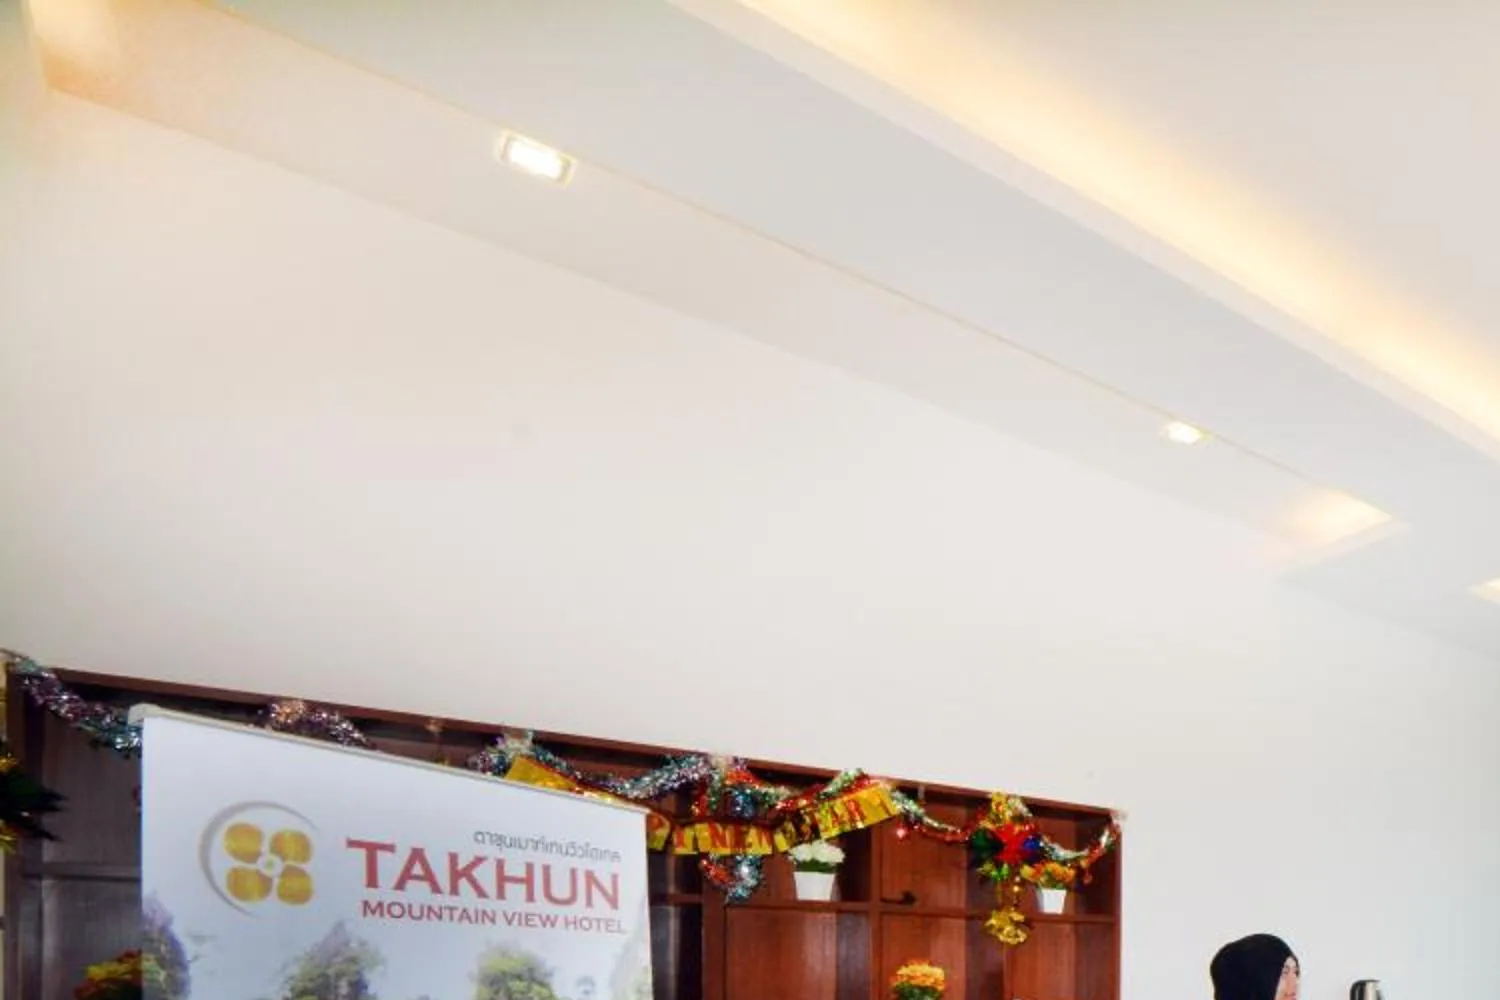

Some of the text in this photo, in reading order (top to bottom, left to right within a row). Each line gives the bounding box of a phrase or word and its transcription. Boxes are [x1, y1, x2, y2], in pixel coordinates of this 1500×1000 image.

[345, 837, 620, 911] TAKHUN
[361, 899, 626, 934] MOUNTAIN VIEW HOTEL
